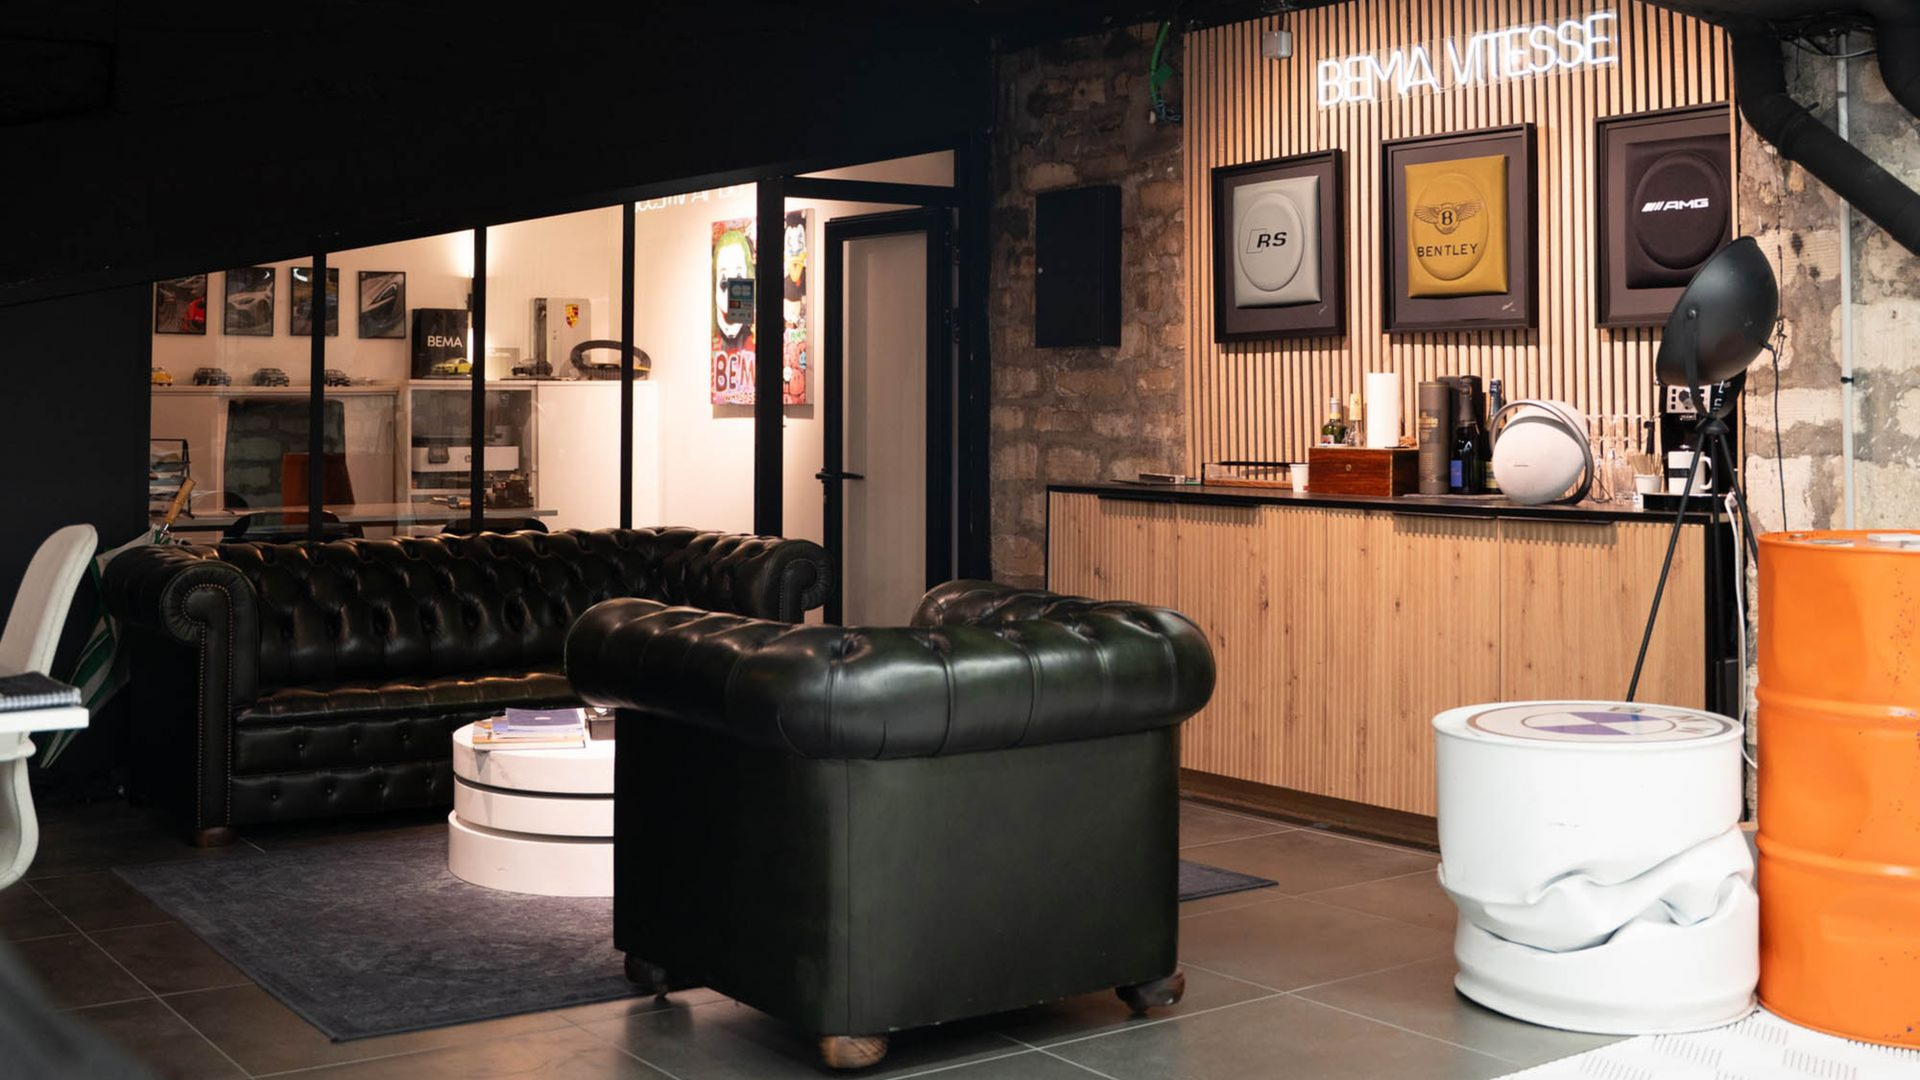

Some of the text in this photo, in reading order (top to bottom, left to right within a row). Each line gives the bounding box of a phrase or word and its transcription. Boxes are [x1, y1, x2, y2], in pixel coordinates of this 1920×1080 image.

[1317, 11, 1618, 108] BEMA VITESSE
[1663, 198, 1709, 211] AMG
[1257, 231, 1287, 248] RS
[1417, 243, 1478, 257] BENTLEY
[427, 335, 463, 348] BEMA
[715, 352, 756, 393] BEM
